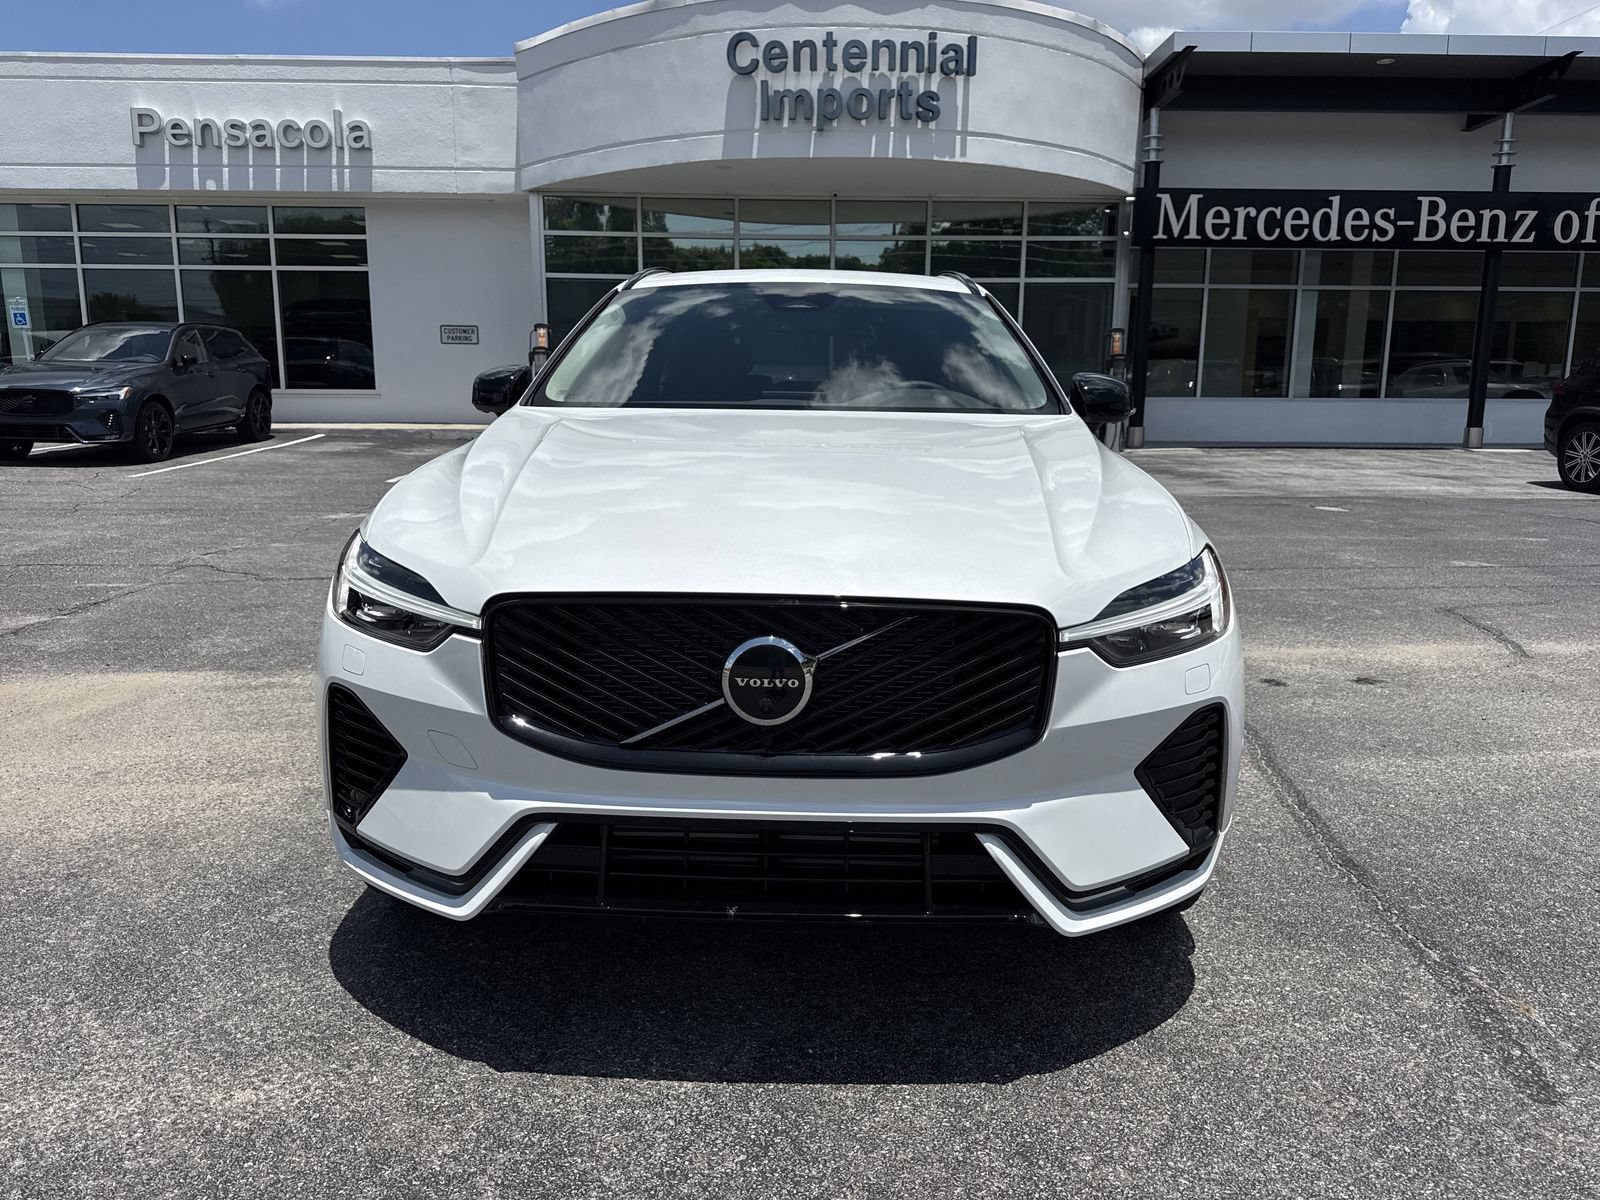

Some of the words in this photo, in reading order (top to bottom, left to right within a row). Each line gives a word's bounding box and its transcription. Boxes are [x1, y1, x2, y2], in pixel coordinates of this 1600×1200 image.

[727, 31, 977, 77] Centennial
[760, 80, 941, 131] Imports
[130, 107, 372, 150] Pensacola
[1153, 193, 1539, 242] Mercedes-Benz
[1553, 197, 1600, 244] of
[443, 327, 476, 335] CUSTOMER
[734, 677, 799, 688] VOLVO
